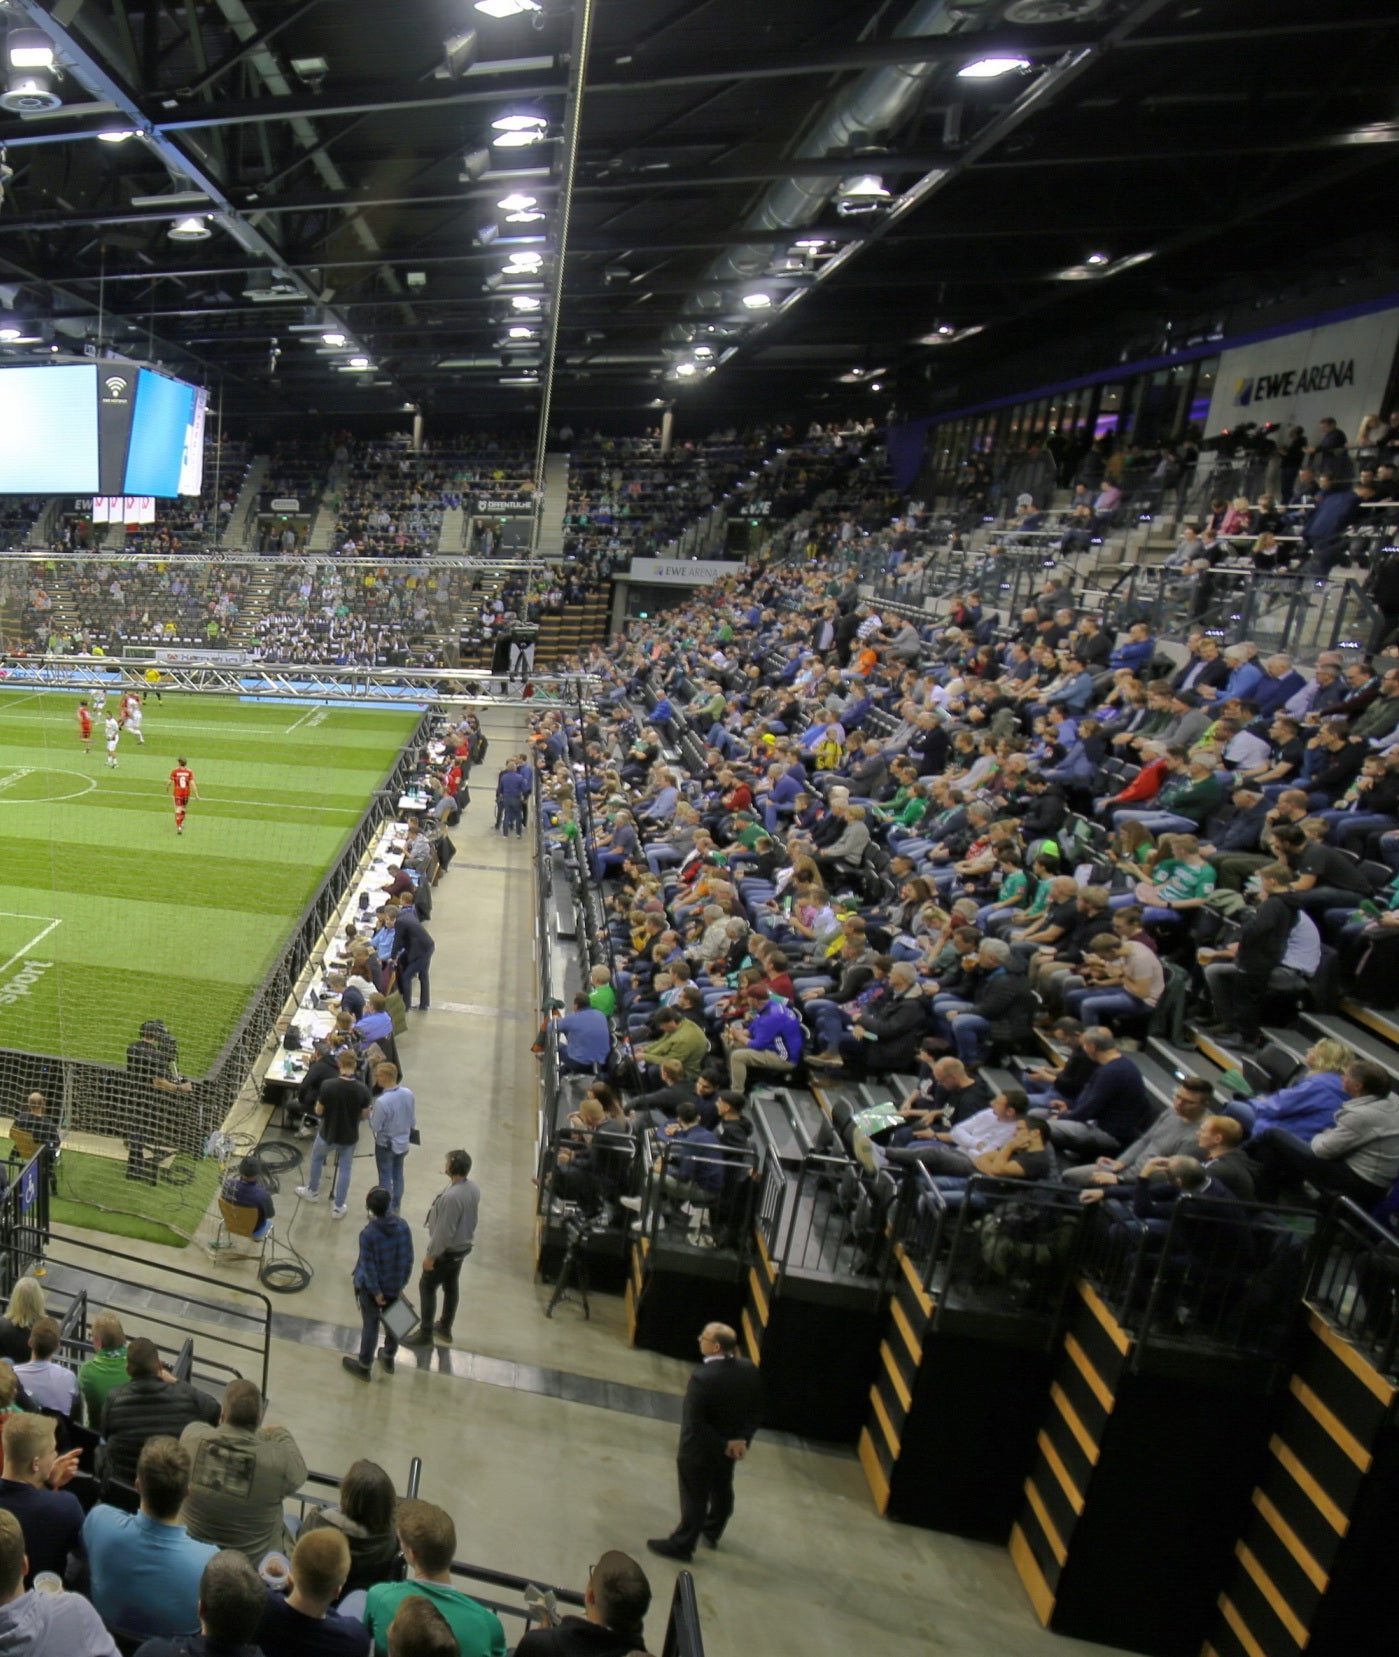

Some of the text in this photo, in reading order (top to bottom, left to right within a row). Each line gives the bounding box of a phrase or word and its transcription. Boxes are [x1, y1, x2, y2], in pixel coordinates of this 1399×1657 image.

[1254, 359, 1354, 401] EWE ARENA
[75, 499, 93, 510] EW
[666, 567, 718, 577] EWE ARENA
